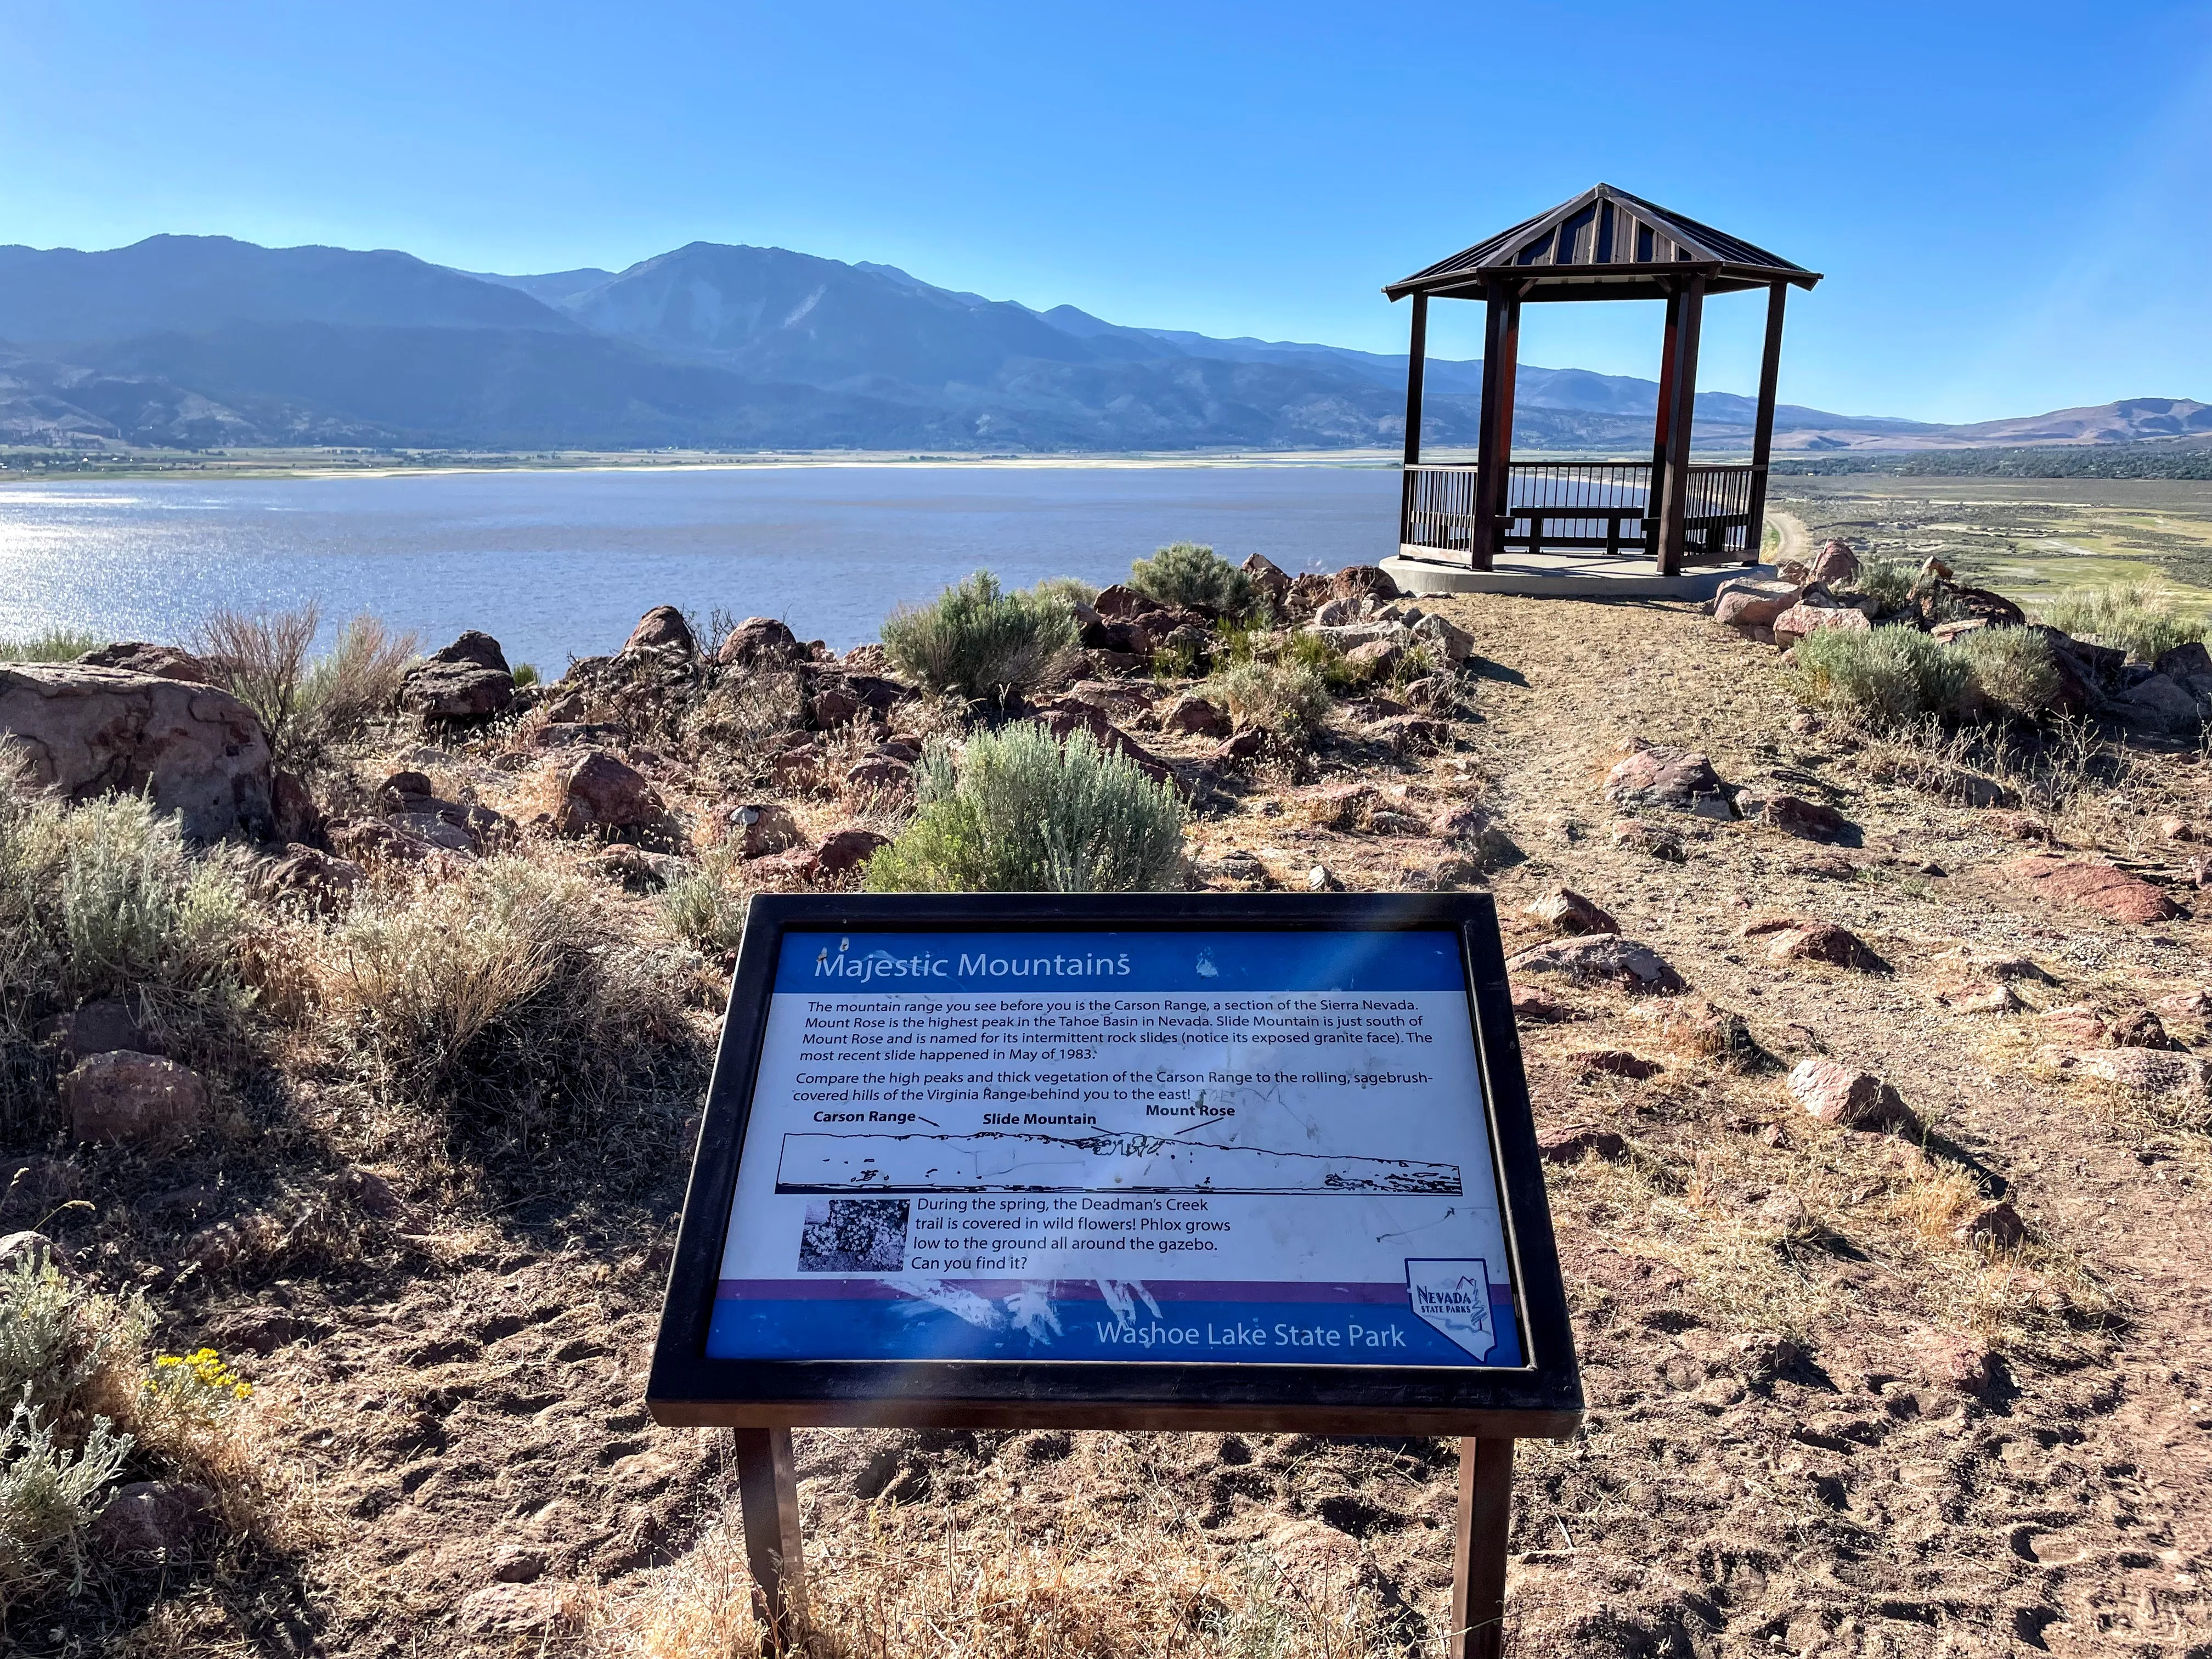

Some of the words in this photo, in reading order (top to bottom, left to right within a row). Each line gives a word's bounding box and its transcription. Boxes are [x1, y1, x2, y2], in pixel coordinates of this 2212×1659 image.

[814, 953, 949, 983] Majestic
[957, 953, 1131, 977] Mountains
[808, 1001, 833, 1012] The
[836, 1001, 901, 1012] mountain
[904, 1003, 943, 1014] range
[945, 1003, 970, 1014] you
[974, 1003, 997, 1011] see
[1000, 998, 1043, 1011] before
[1046, 1003, 1071, 1013] you
[1075, 1000, 1085, 1011] is
[1088, 1000, 1111, 1011] the
[1114, 1000, 1160, 1011] Carson
[1164, 1000, 1210, 1013] Range,
[1213, 1002, 1221, 1011] a
[1224, 1000, 1273, 1011] section
[1277, 999, 1291, 1010] of
[1294, 999, 1317, 1011] the
[1320, 1000, 1359, 1011] Sierra
[1361, 999, 1419, 1010] Nevada.
[805, 1018, 850, 1028] Mount
[854, 1017, 885, 1028] Rose
[889, 1017, 899, 1028] is
[902, 1017, 924, 1028] the
[928, 1016, 979, 1030] highest
[981, 1016, 1014, 1030] peak
[1016, 1016, 1030, 1027] in
[1033, 1015, 1056, 1027] the
[1058, 1016, 1099, 1027] Tahoe
[1103, 1016, 1138, 1027] Basin
[1142, 1016, 1155, 1027] in
[1159, 1015, 1213, 1027] Nevada.
[1216, 1015, 1250, 1026] Slide
[1253, 1015, 1319, 1026] Mountain
[1323, 1016, 1334, 1026] is
[1336, 1015, 1363, 1029] just
[1365, 1015, 1405, 1026] south
[1409, 1015, 1423, 1026] of
[802, 1034, 848, 1045] Mount
[851, 1034, 883, 1045] Rose
[887, 1032, 913, 1044] and
[916, 1033, 926, 1044] is
[930, 1032, 977, 1043] named
[980, 1032, 1000, 1043] for
[1003, 1032, 1018, 1043] its
[1022, 1032, 1104, 1043] intermittent
[1108, 1031, 1137, 1043] rock
[1139, 1031, 1178, 1043] slides
[1182, 1031, 1229, 1045] (notice
[1232, 1032, 1248, 1043] its
[1252, 1031, 1310, 1046] exposed
[1313, 1032, 1363, 1046] granite
[1366, 1031, 1404, 1045] face).
[1408, 1031, 1432, 1043] The
[800, 1051, 834, 1062] most
[837, 1051, 881, 1062] recent
[884, 1049, 916, 1060] slide
[919, 1049, 990, 1063] happened
[992, 1049, 1006, 1060] in
[1009, 1048, 1039, 1063] May
[1041, 1048, 1057, 1059] of
[1059, 1049, 1096, 1060] 1983.
[796, 1073, 859, 1086] Compare
[862, 1072, 885, 1084] the
[889, 1071, 920, 1086] high
[923, 1071, 963, 1086] peaks
[967, 1071, 994, 1083] and
[997, 1071, 1031, 1082] thick
[1034, 1071, 1108, 1085] vegetation
[1113, 1070, 1128, 1082] of
[1130, 1070, 1153, 1082] the
[1156, 1071, 1204, 1082] Carson
[1209, 1071, 1252, 1086] Range
[1256, 1073, 1271, 1083] to
[1274, 1071, 1298, 1083] the
[1301, 1071, 1352, 1086] rolling,
[1354, 1071, 1433, 1086] sagebrush-
[793, 1089, 849, 1101] covered
[852, 1089, 880, 1101] hills
[883, 1088, 899, 1101] of
[901, 1088, 924, 1101] the
[927, 1088, 979, 1103] Virginia
[983, 1088, 1026, 1103] Range
[1030, 1088, 1080, 1101] behind
[1083, 1091, 1109, 1103] you
[1113, 1089, 1128, 1099] to
[1131, 1088, 1155, 1100] the
[1158, 1088, 1190, 1100] east!
[813, 1111, 865, 1122] Carson
[868, 1110, 916, 1125] Range
[1146, 1104, 1196, 1116] Mount
[1200, 1104, 1236, 1116] Rose
[983, 1113, 1020, 1125] Slide
[1023, 1113, 1097, 1125] Mountain
[917, 1198, 968, 1213] During
[972, 1197, 996, 1210] the
[1000, 1198, 1049, 1213] spring,
[1053, 1197, 1077, 1210] the
[1166, 1198, 1209, 1211] Creek
[915, 1216, 944, 1229] trail
[947, 1217, 958, 1229] is
[962, 1216, 1021, 1229] covered
[1025, 1217, 1039, 1229] in
[1042, 1216, 1074, 1230] wild
[1077, 1216, 1136, 1231] flowers!
[1141, 1217, 1182, 1231] Phlox
[1186, 1221, 1231, 1234] grows
[913, 1236, 940, 1249] low
[944, 1237, 960, 1250] to
[963, 1236, 988, 1249] the
[992, 1236, 1047, 1252] ground
[1051, 1236, 1068, 1249] all
[1071, 1237, 1125, 1250] around
[1129, 1237, 1154, 1250] the
[1159, 1237, 1217, 1254] gazebo.
[911, 1256, 939, 1269] Can
[943, 1260, 972, 1273] you
[975, 1255, 1006, 1269] find
[1009, 1256, 1028, 1269] it?
[1421, 1305, 1444, 1313] STATE
[1446, 1305, 1471, 1313] PARKS
[1096, 1321, 1200, 1346] Washoe
[1207, 1322, 1267, 1346] Lake
[1274, 1323, 1341, 1346] State
[1348, 1324, 1407, 1347] Park
